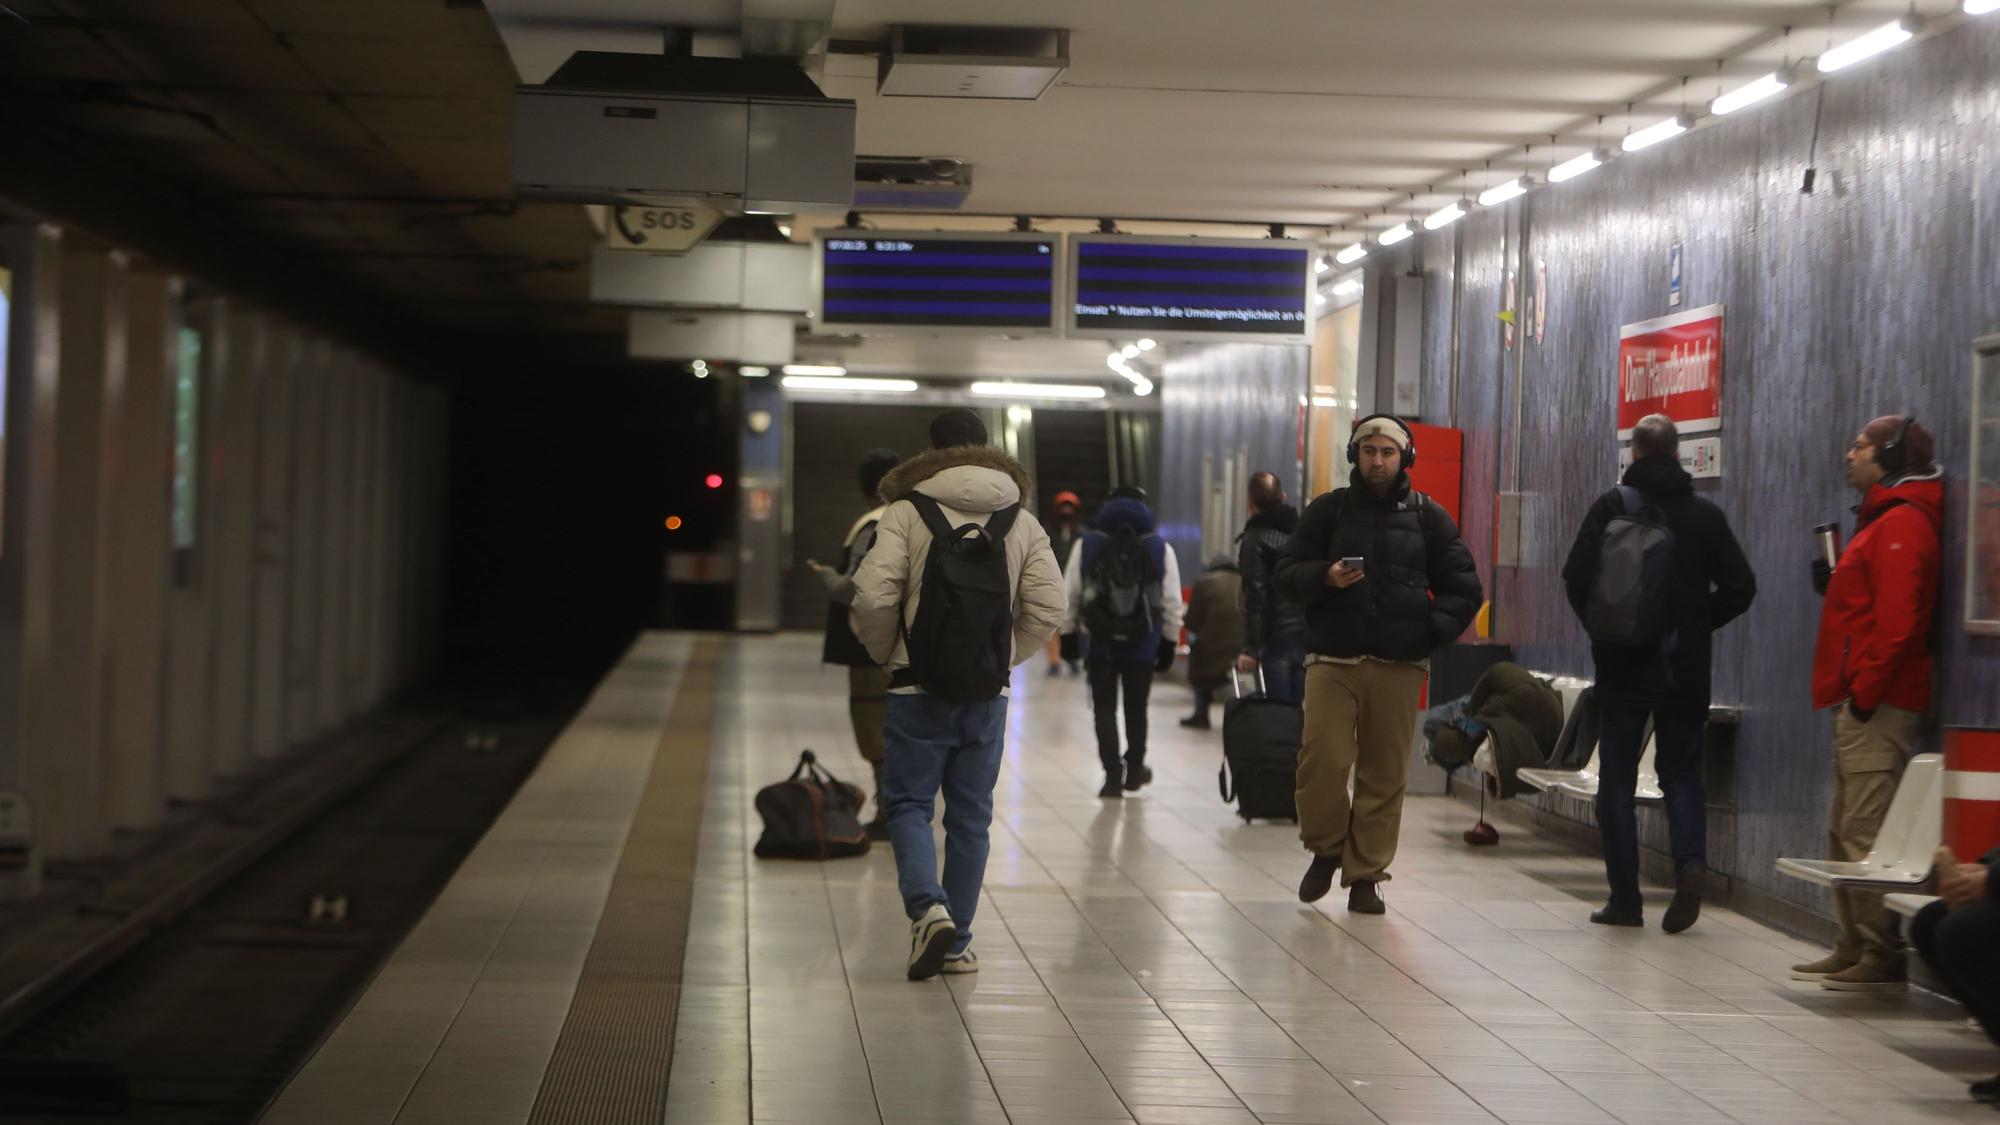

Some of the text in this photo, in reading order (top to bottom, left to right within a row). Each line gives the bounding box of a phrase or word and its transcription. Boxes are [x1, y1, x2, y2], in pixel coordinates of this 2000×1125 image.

[643, 210, 694, 230] SOS
[1075, 304, 1109, 316] Einsatz
[1117, 305, 1152, 317] Nutzen
[1152, 306, 1168, 318] Sie
[1168, 307, 1184, 318] die
[1184, 307, 1280, 321] Umsteigemöglichkeit
[1282, 311, 1295, 321] an
